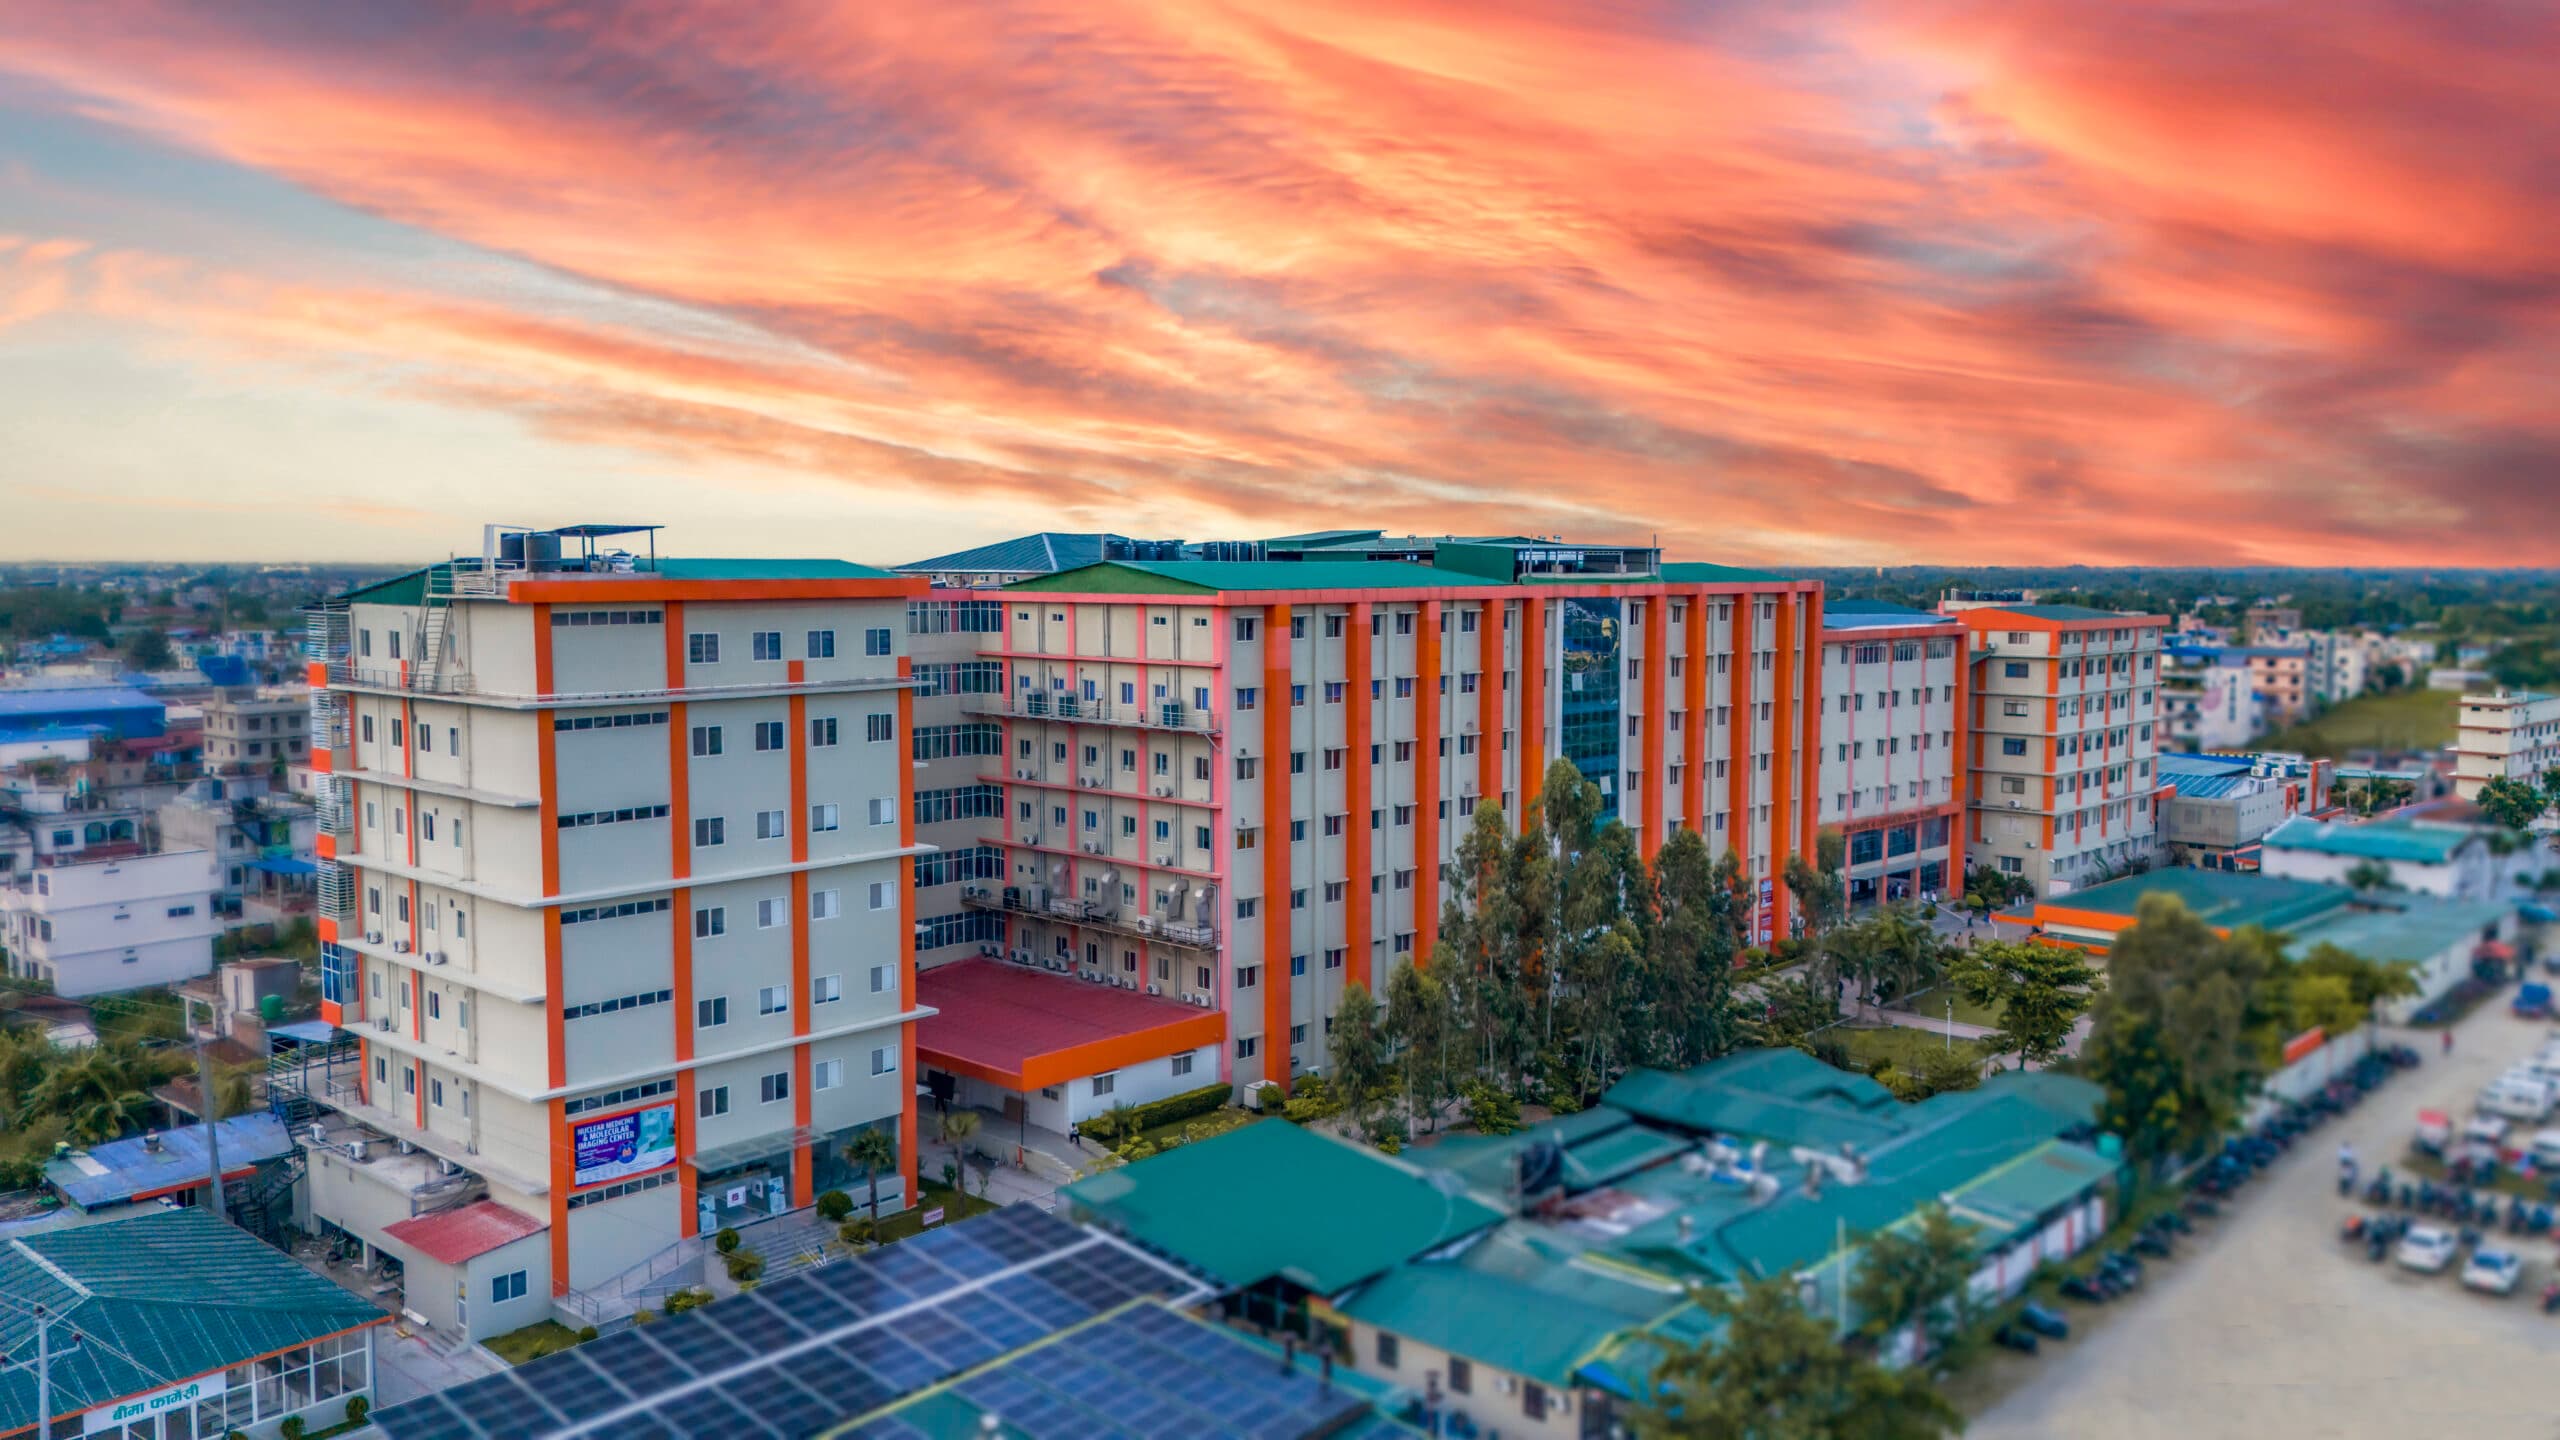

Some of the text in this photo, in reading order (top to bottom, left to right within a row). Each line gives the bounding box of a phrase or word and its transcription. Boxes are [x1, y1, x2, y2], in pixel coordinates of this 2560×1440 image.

[578, 1116, 634, 1136] NUCLEAR MEDICINE
[583, 1125, 629, 1141] & MOLECULAR
[578, 1130, 634, 1151] IMAGING CENTER
[113, 1402, 145, 1420] बीमा
